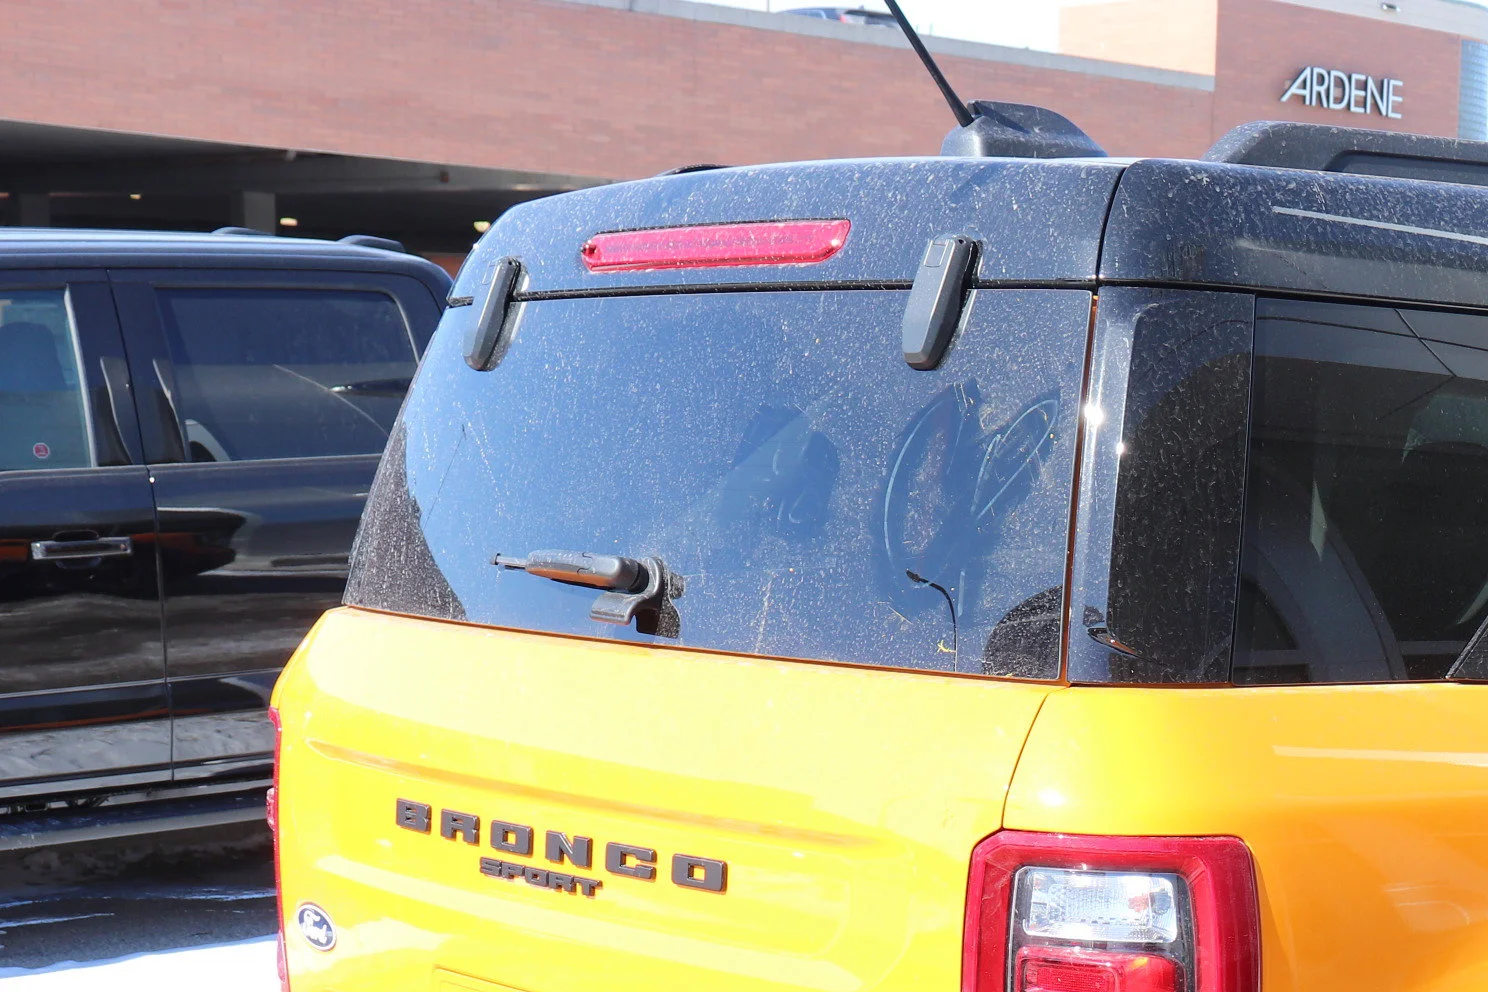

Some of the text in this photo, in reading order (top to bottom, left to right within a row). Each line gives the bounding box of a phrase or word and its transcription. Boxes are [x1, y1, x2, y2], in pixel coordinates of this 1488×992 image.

[1280, 66, 1403, 119] ARDENE
[396, 798, 727, 893] BRONCO
[480, 857, 602, 896] SPORT
